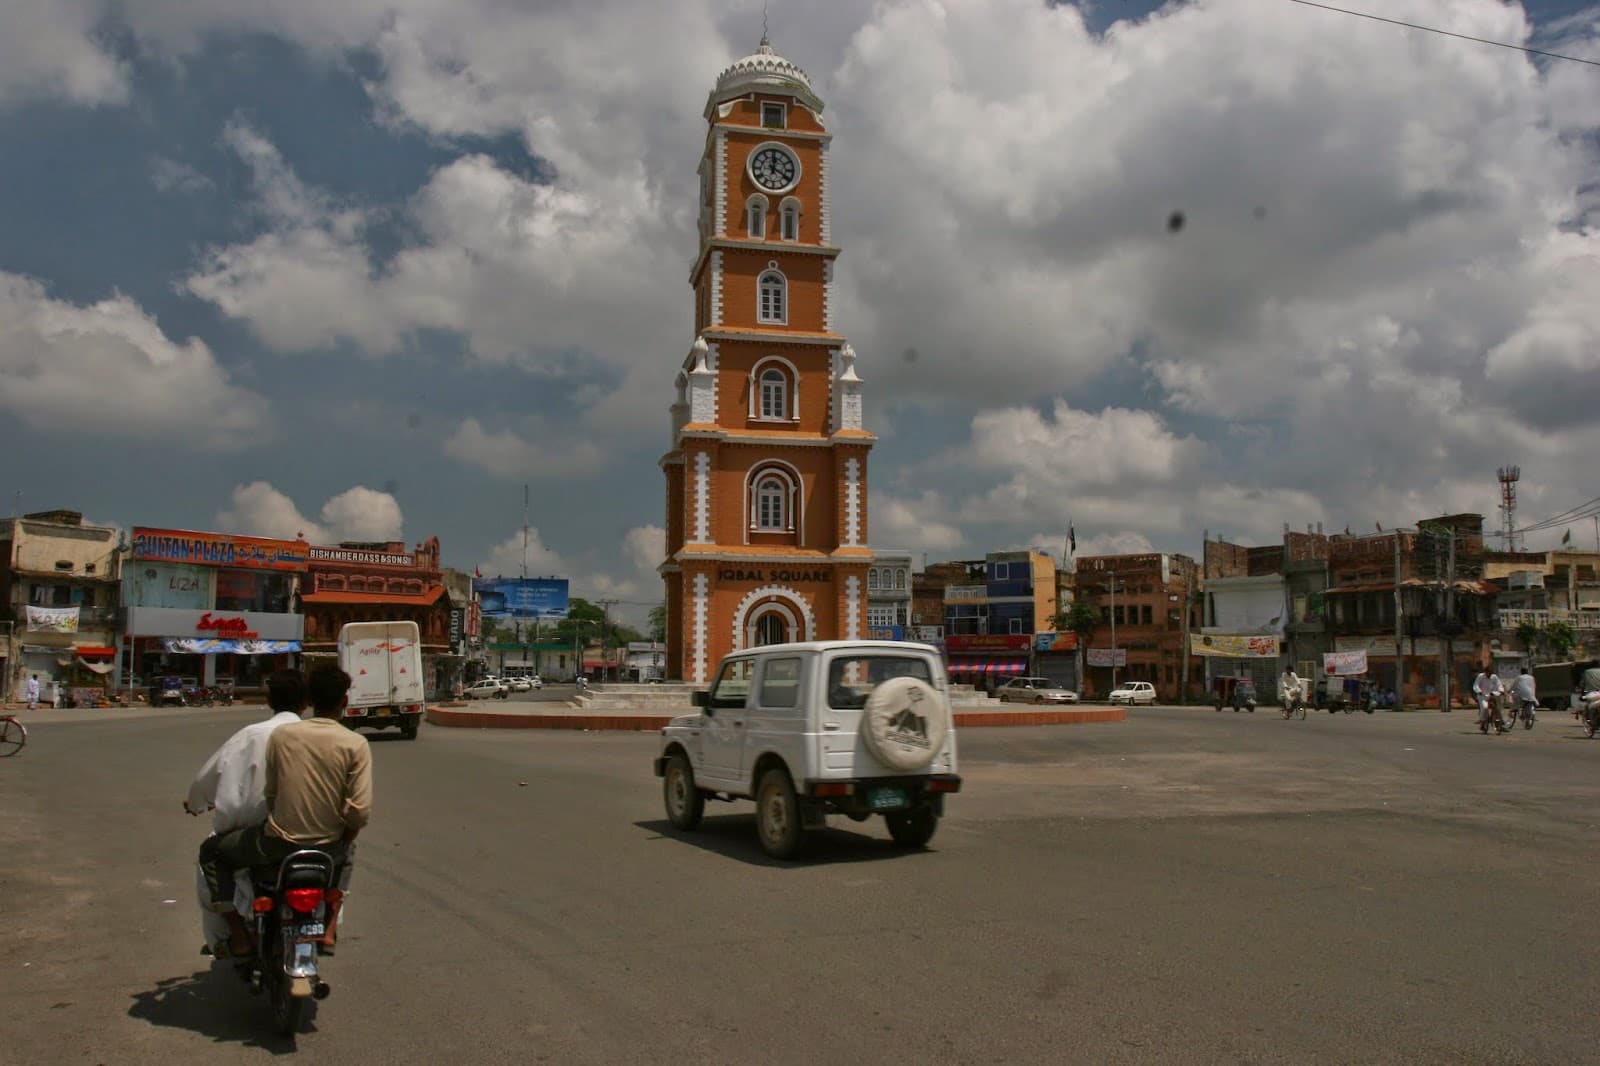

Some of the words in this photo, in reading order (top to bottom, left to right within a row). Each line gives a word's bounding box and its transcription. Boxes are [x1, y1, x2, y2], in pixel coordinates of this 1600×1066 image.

[136, 534, 189, 559] SULTAN
[194, 540, 235, 563] PLAZA
[719, 569, 765, 581] IQBAL
[769, 570, 831, 582] SQUARE
[450, 610, 459, 642] RADO
